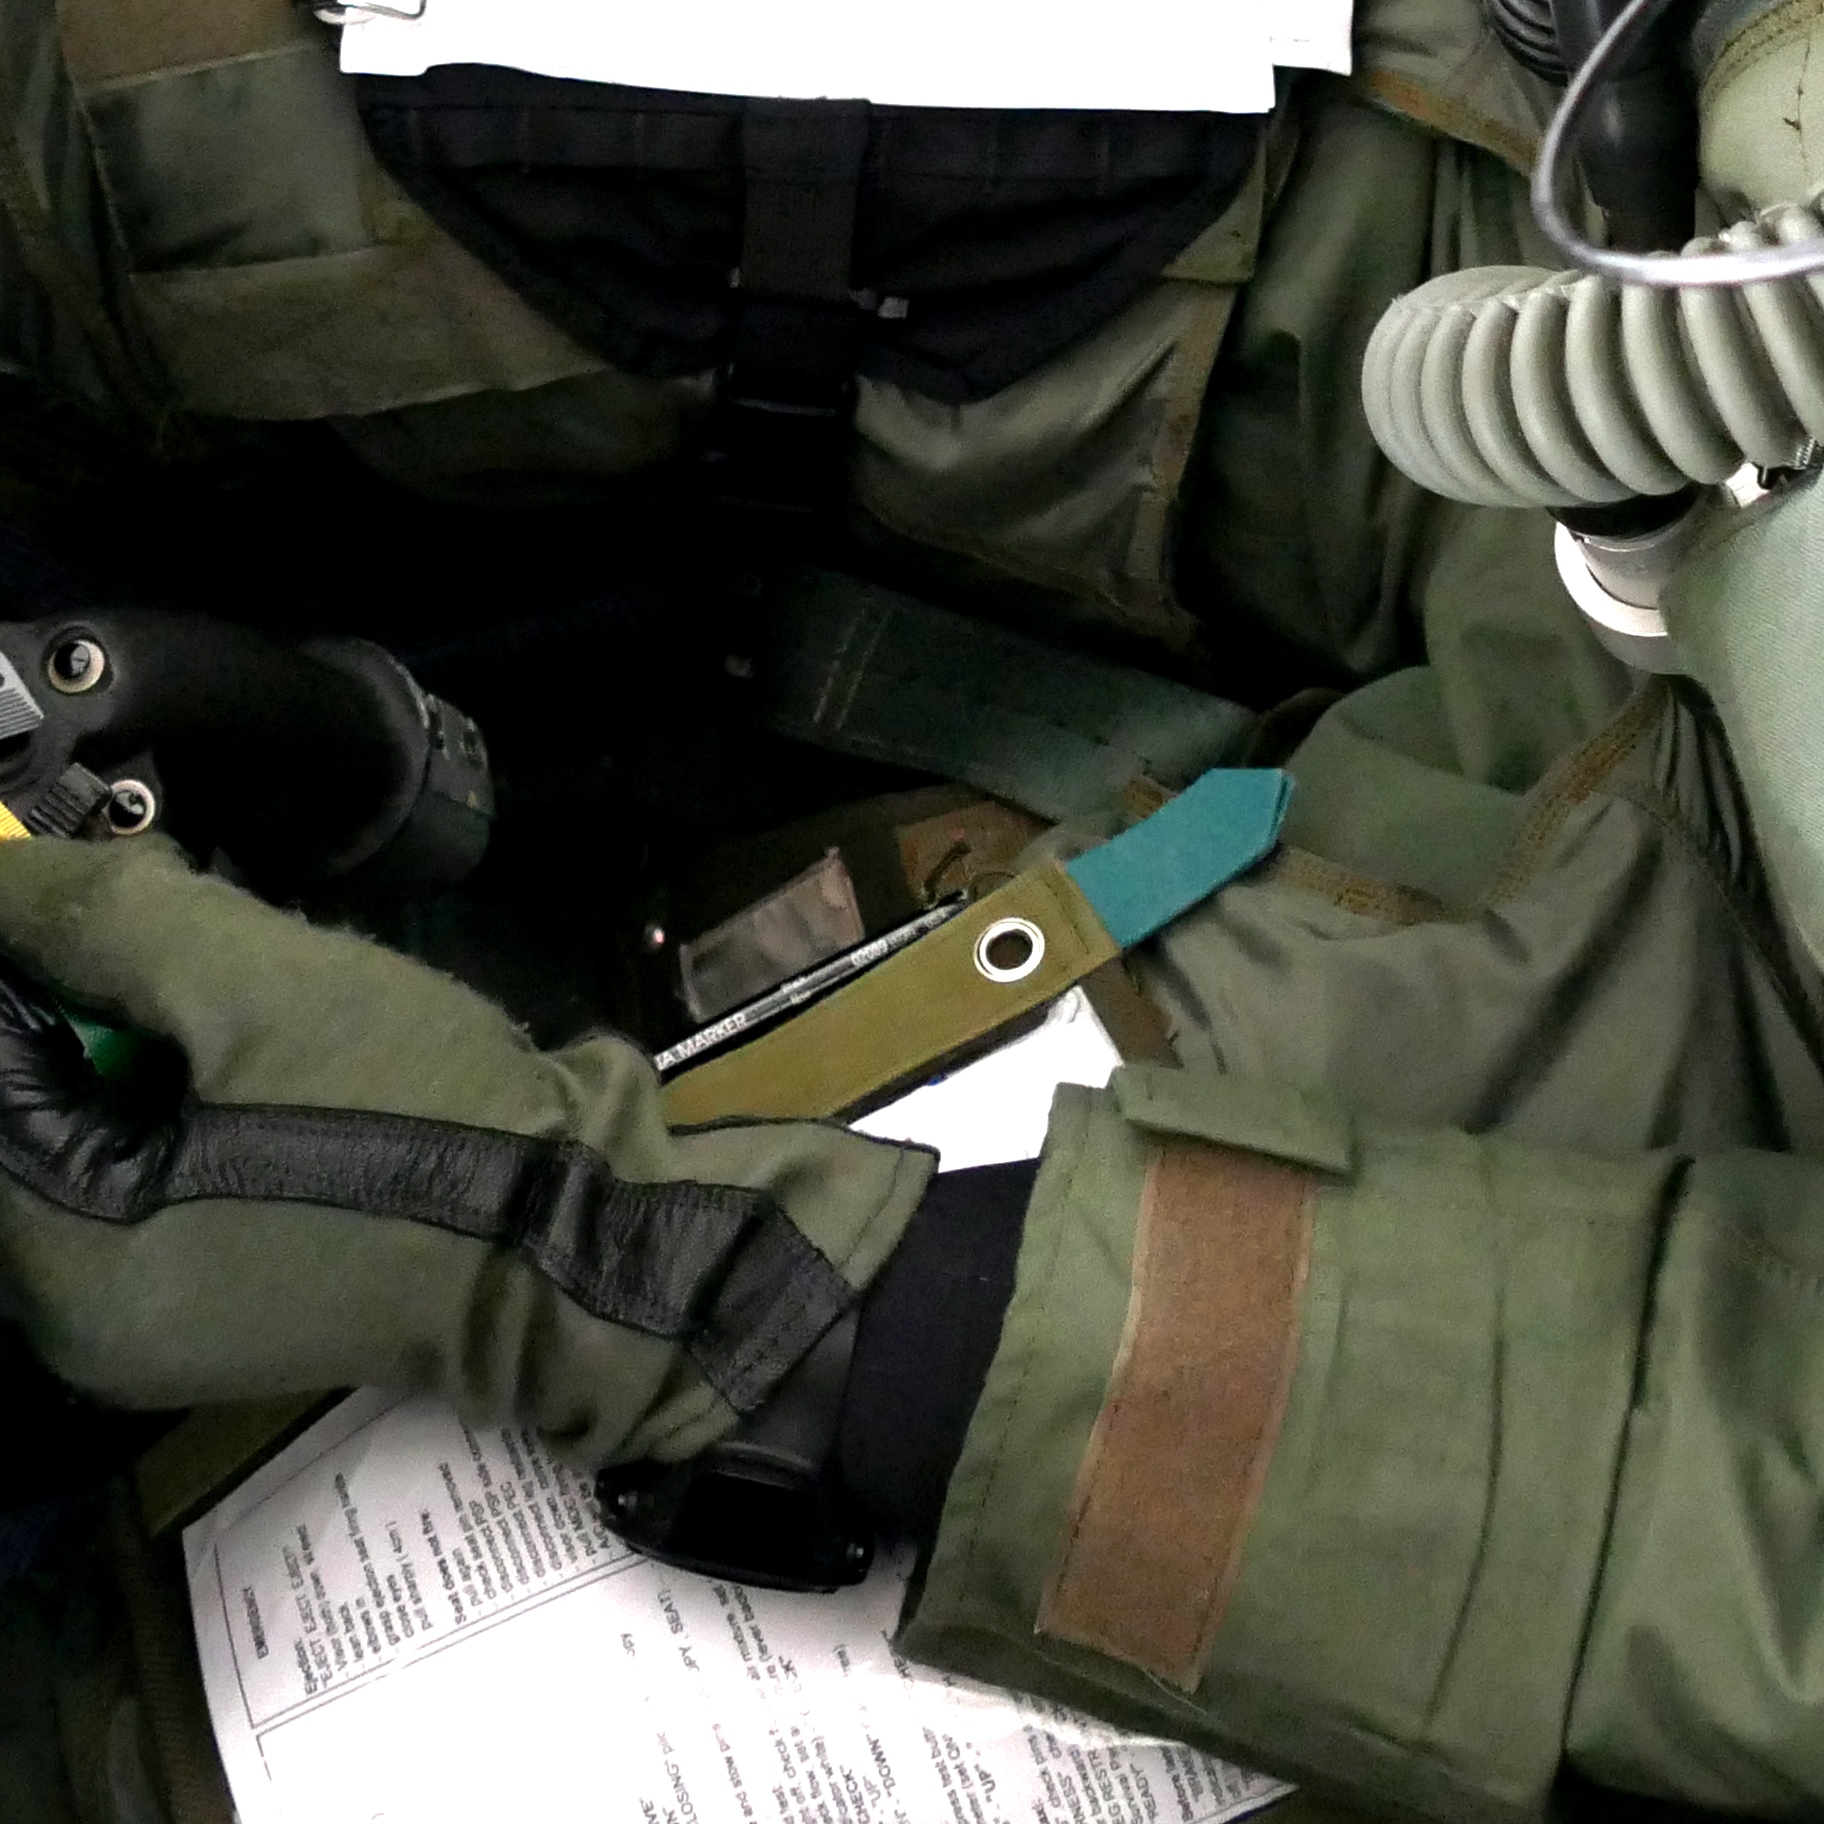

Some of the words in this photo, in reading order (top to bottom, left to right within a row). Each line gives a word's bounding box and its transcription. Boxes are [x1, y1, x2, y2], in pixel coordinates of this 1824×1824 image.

[675, 1012, 749, 1059] MARKER
[485, 1491, 503, 1518] PSP
[500, 1481, 519, 1510] PEC
[427, 1535, 442, 1557] not
[481, 1526, 513, 1592] disconnect
[497, 1518, 529, 1584] disconnect
[512, 1510, 545, 1577] disconnect
[528, 1502, 562, 1570] disconnect
[437, 1558, 454, 1590] does
[242, 1587, 269, 1658] EMERGENCY
[448, 1591, 467, 1624] Seat
[360, 1610, 381, 1654] elbows
[725, 1756, 742, 1788] stow
[867, 1736, 895, 1796] "DOWN"
[665, 1762, 697, 1824] LOSING"
[736, 1792, 753, 1817] and
[1171, 1773, 1194, 1823] Before
